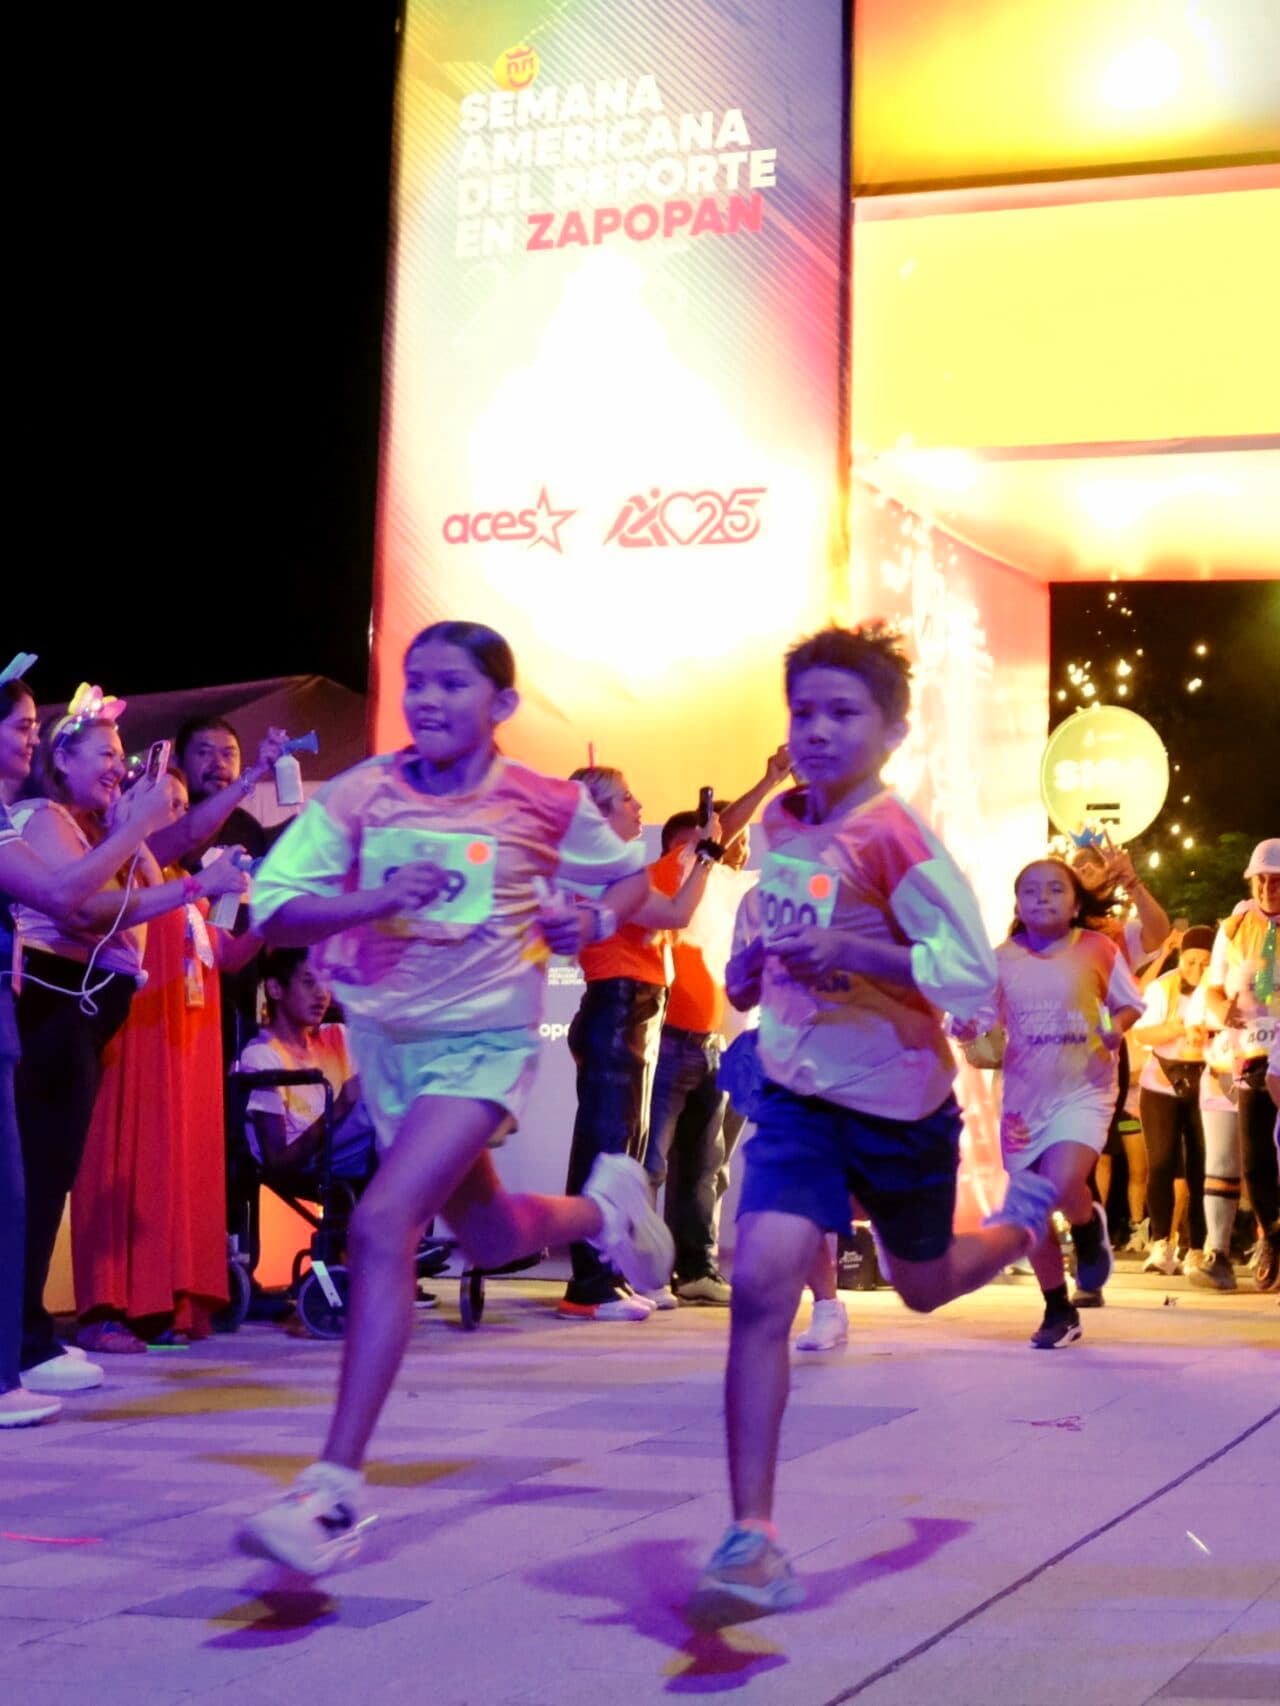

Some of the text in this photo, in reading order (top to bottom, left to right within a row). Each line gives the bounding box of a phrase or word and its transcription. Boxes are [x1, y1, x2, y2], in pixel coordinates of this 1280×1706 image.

[460, 74, 664, 131] SEMANA
[459, 108, 752, 171] AMERICANA
[457, 148, 778, 216] DEL DEPORTE
[456, 193, 763, 258] EN ZAPOPAN
[442, 508, 538, 545] aces
